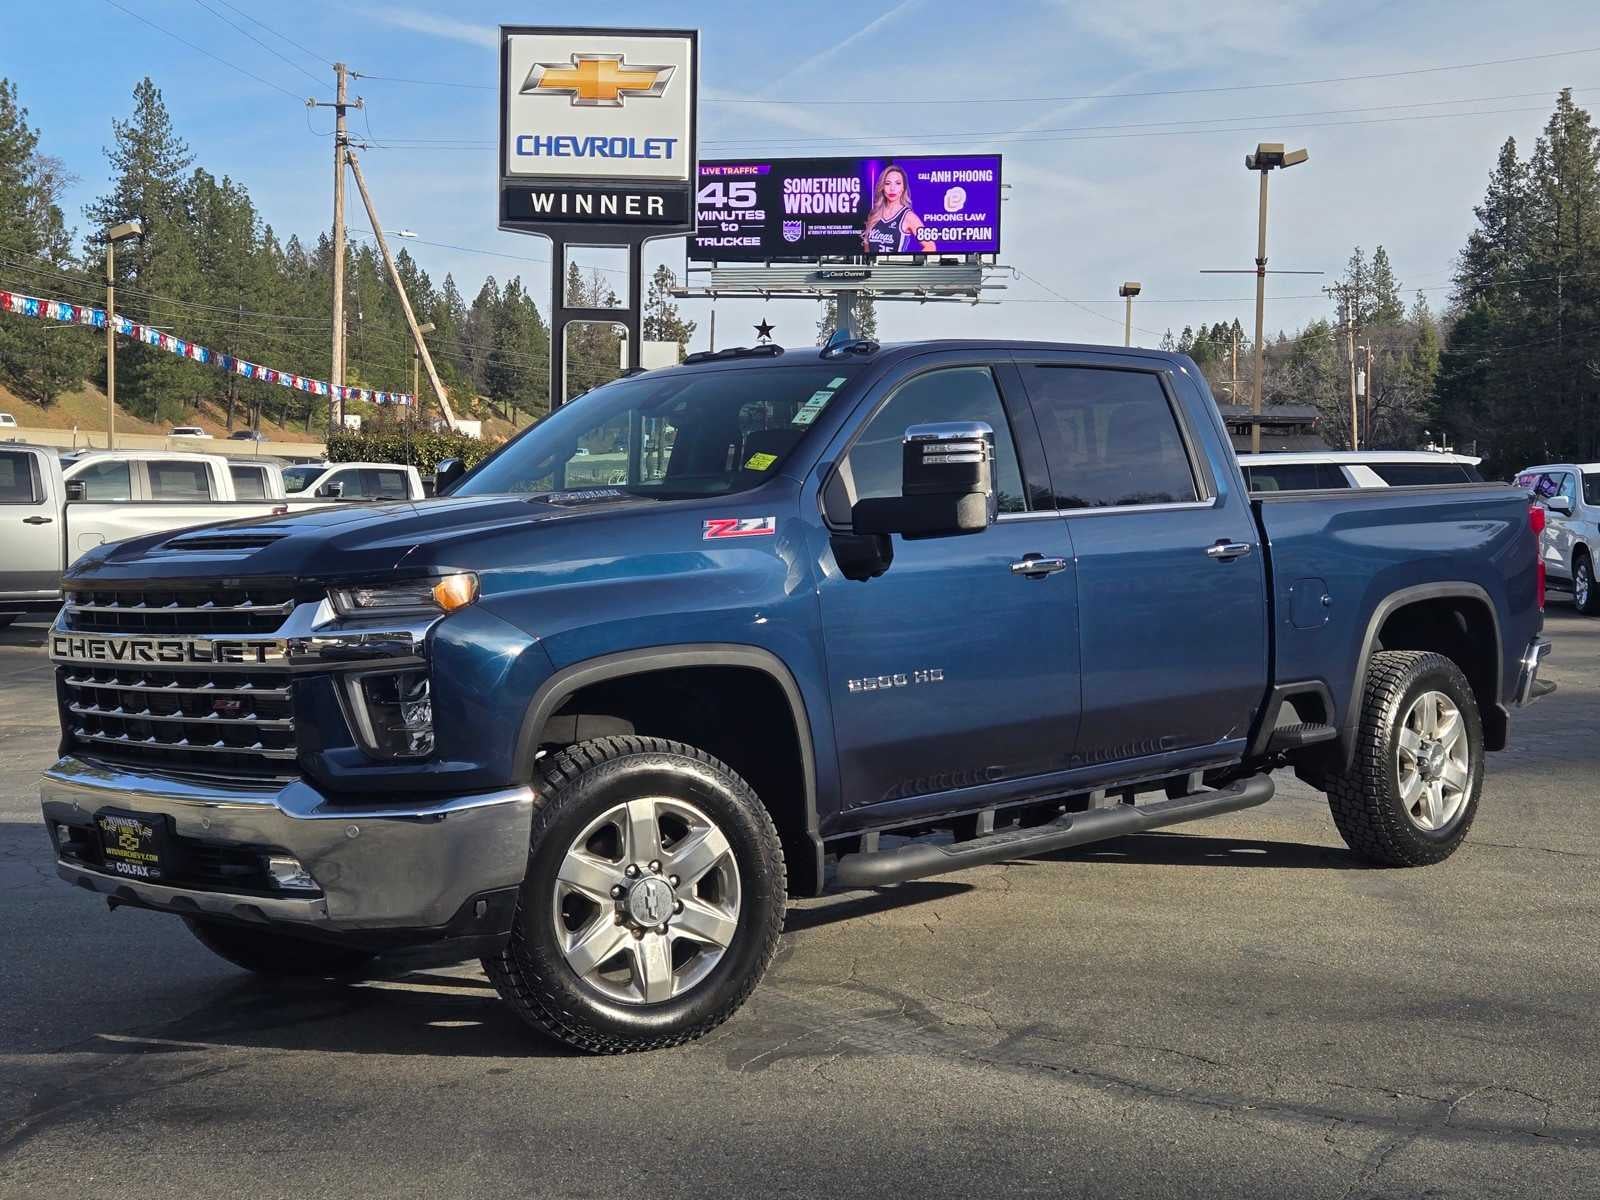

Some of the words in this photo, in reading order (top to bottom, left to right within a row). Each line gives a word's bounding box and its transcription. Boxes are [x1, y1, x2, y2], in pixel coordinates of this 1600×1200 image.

[516, 135, 678, 159] CHEVROLET
[702, 167, 720, 175] LIVE
[722, 166, 758, 174] TRAFFIC
[930, 171, 951, 182] ANH
[952, 170, 993, 182] PHOONG
[783, 177, 860, 194] SOMETHING
[698, 181, 757, 208] 45
[531, 193, 664, 216] WINNER
[783, 192, 860, 214] WRONG?
[698, 210, 765, 221] MINUTES
[923, 213, 964, 222] PHOONG
[964, 213, 986, 221] LAW
[720, 222, 739, 232] to
[917, 227, 992, 241] 866-GOT-PAIN
[696, 237, 761, 247] TRUCKEE
[703, 516, 776, 541] Z71
[53, 637, 277, 664] CHEVROLET
[914, 669, 943, 683] HD
[116, 862, 149, 877] COLFAX
